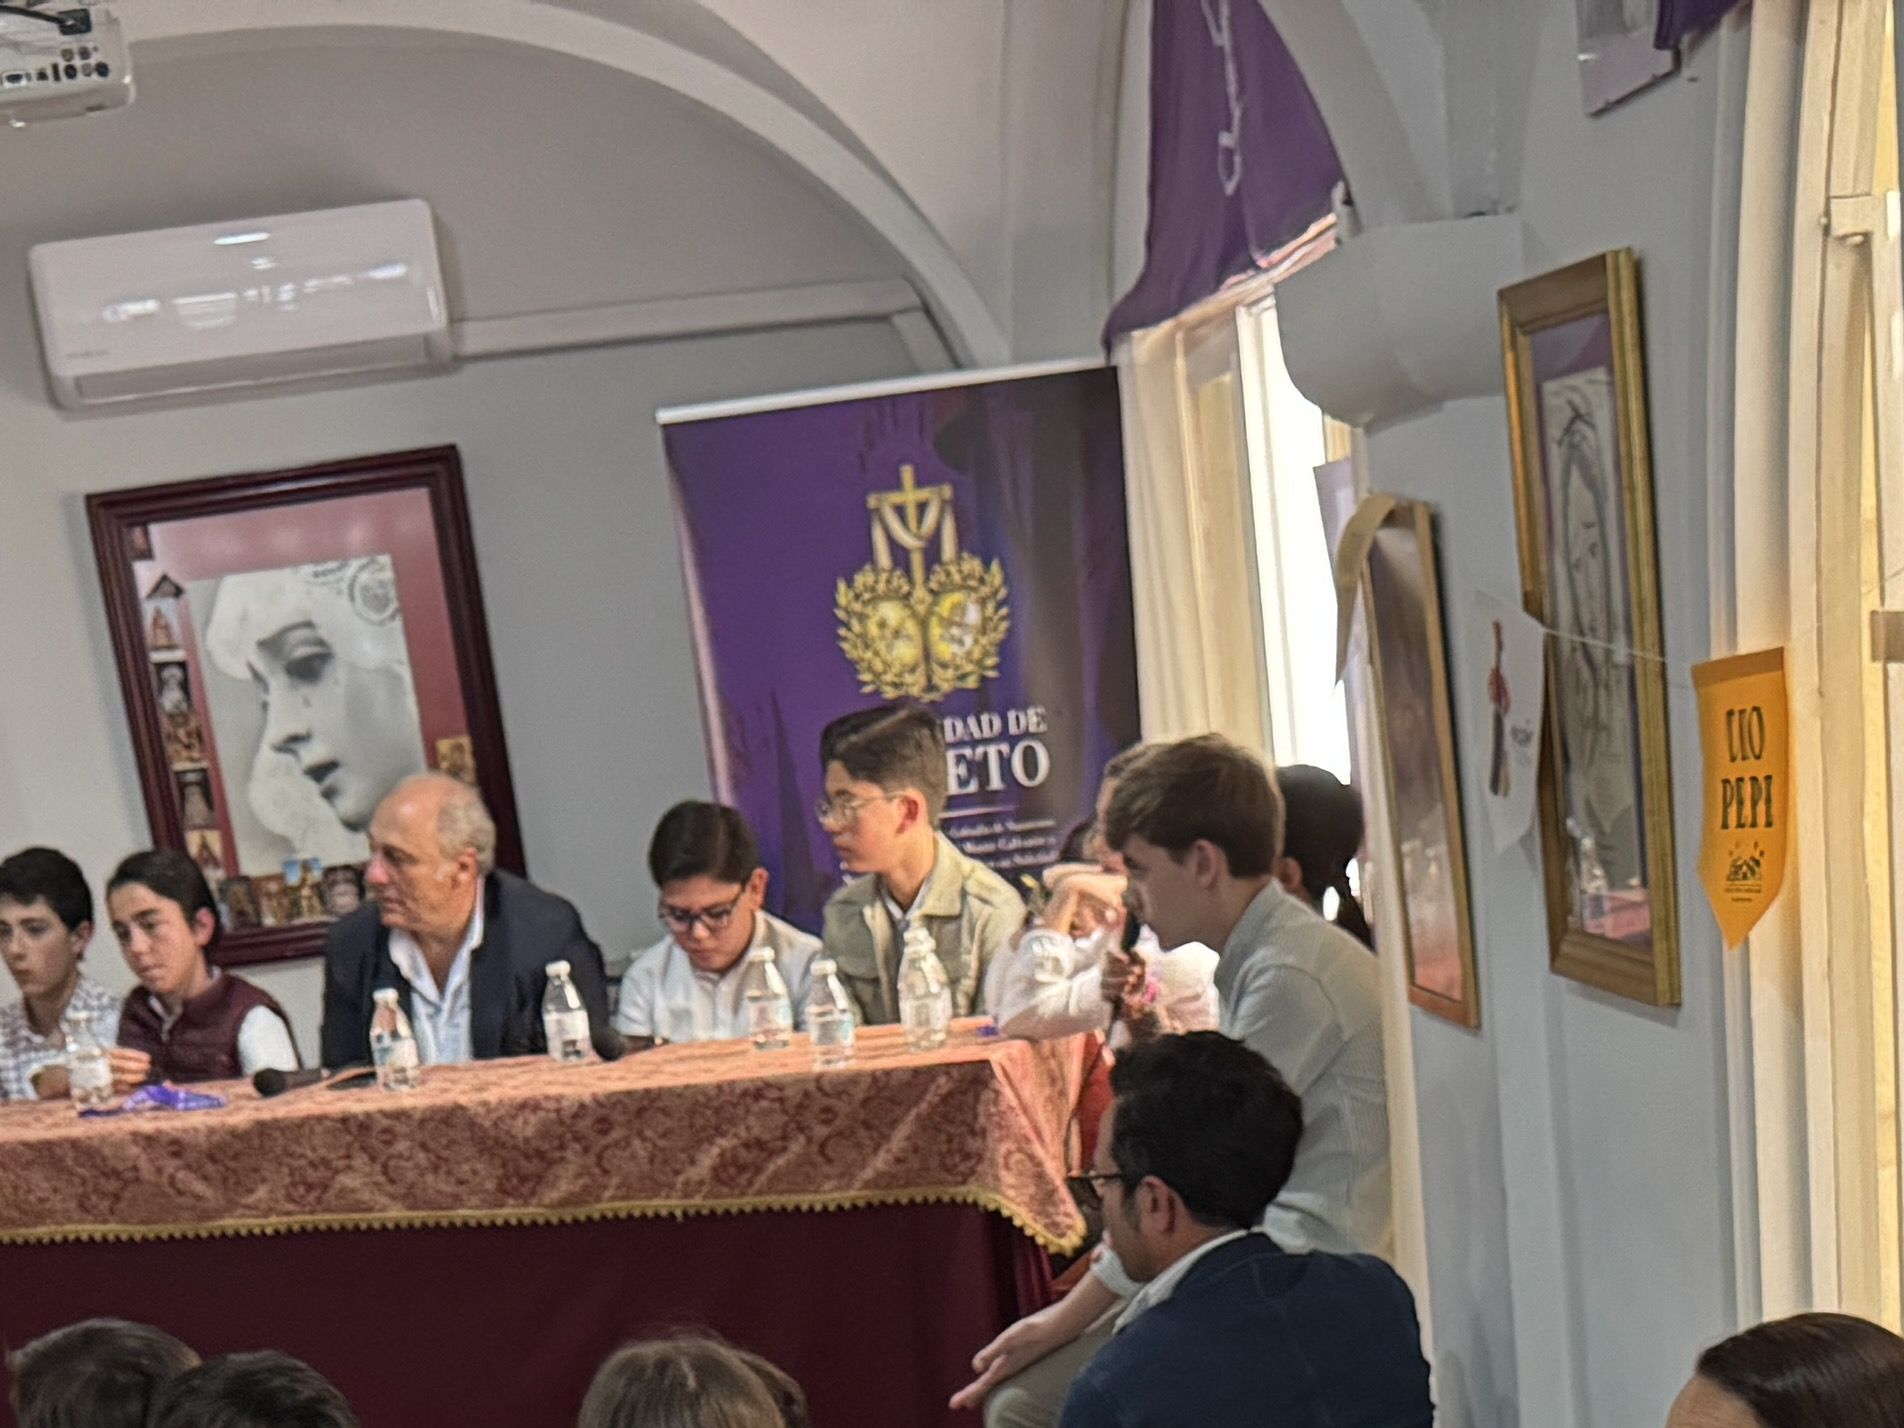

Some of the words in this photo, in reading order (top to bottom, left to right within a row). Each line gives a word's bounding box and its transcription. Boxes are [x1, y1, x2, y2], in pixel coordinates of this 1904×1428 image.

[943, 711, 1003, 745] DAD
[1007, 704, 1048, 737] DE
[946, 738, 1051, 796] ETO
